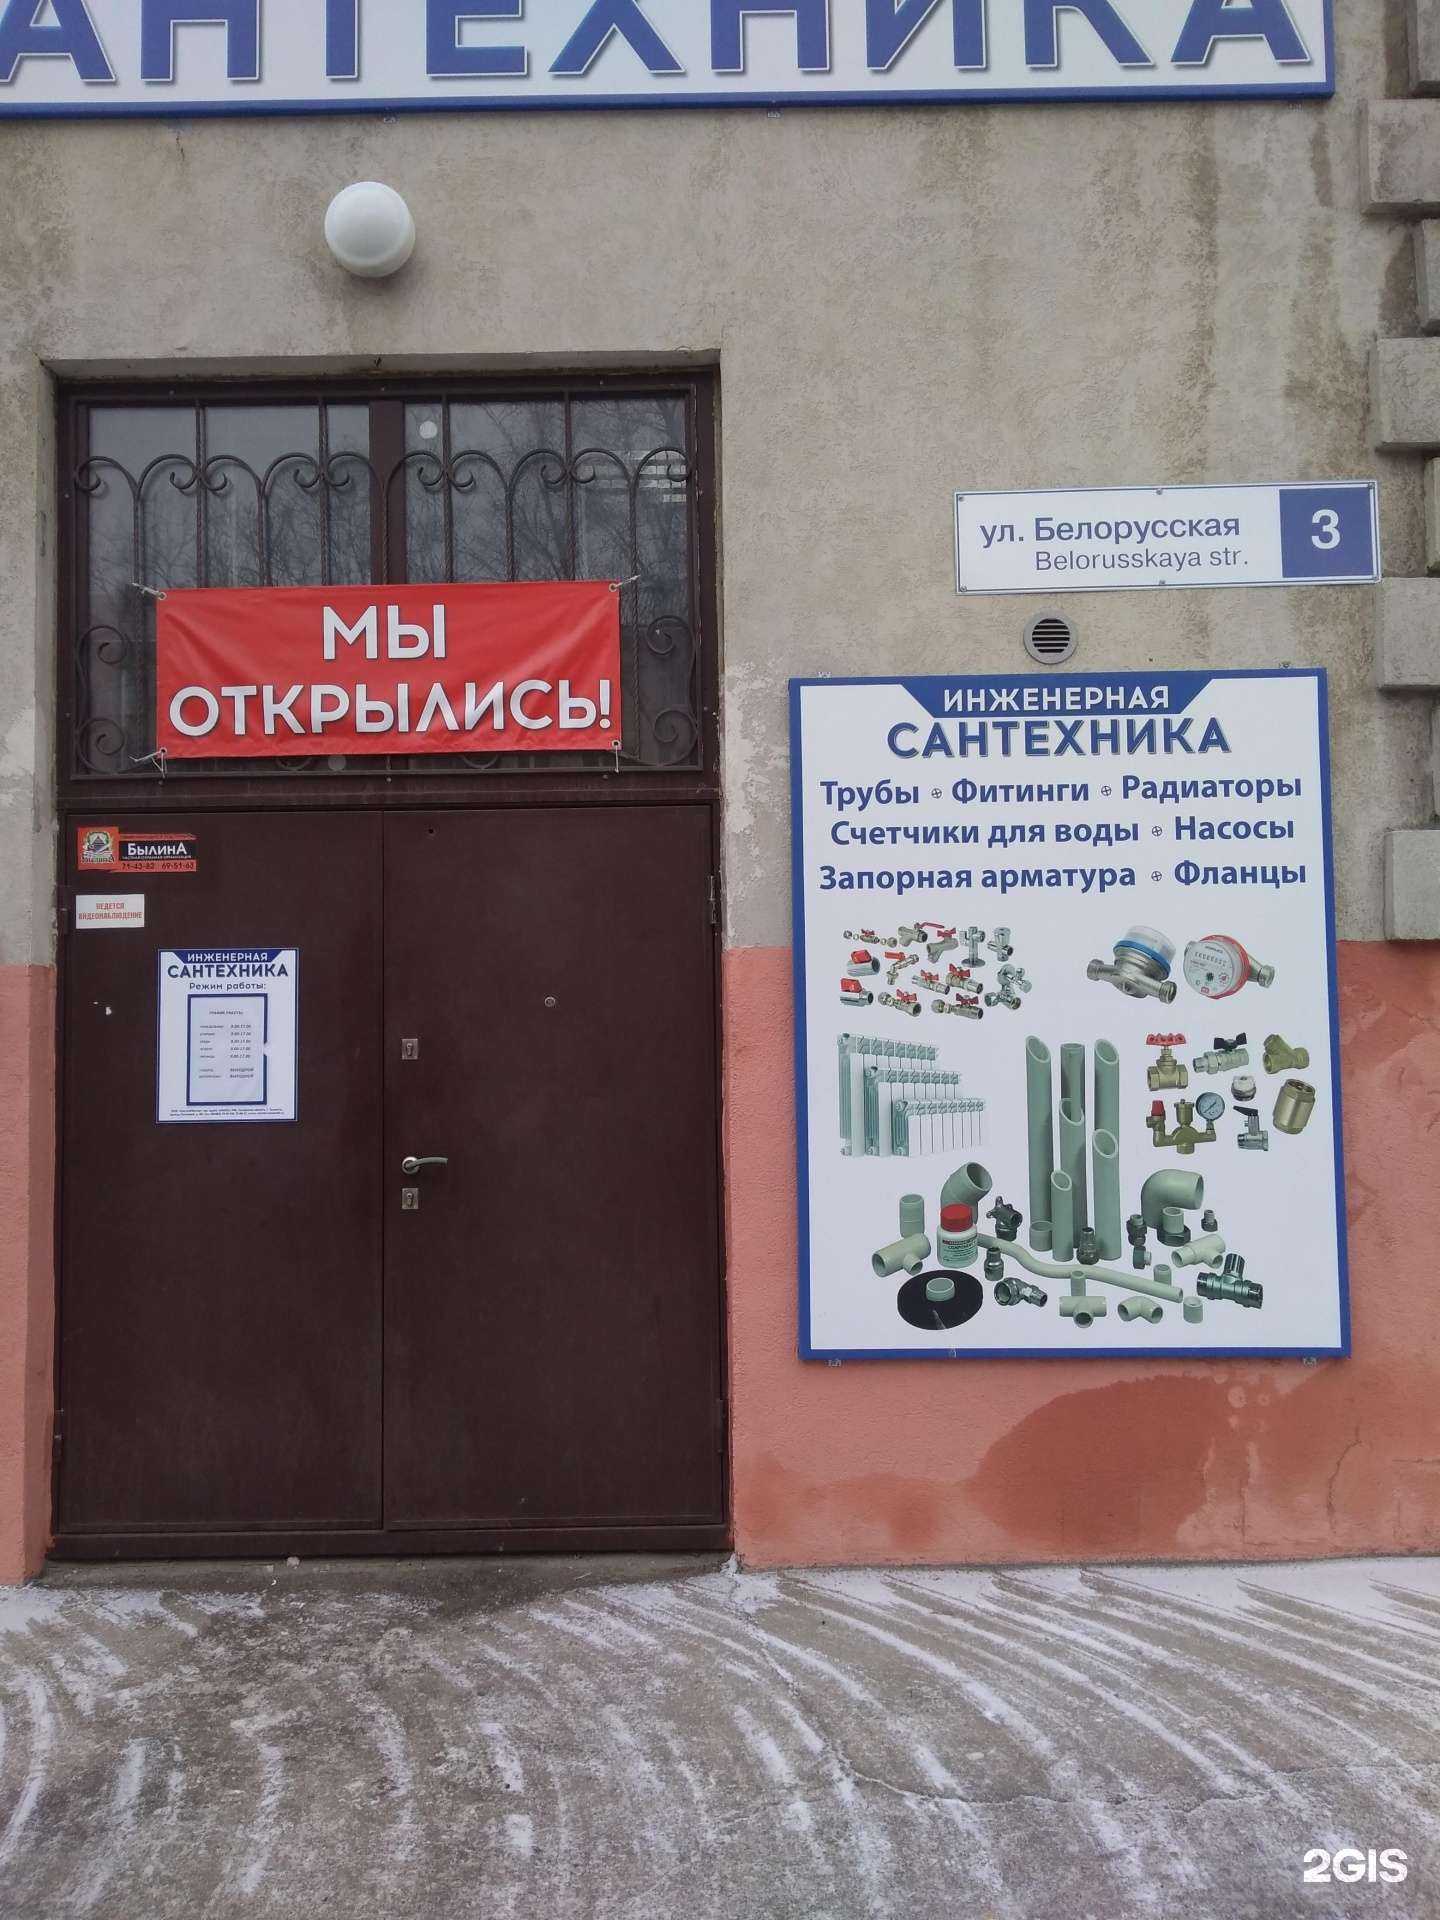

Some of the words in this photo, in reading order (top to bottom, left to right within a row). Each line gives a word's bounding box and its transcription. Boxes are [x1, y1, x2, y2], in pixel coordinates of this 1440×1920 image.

[980, 522, 1025, 548] ул.
[1034, 517, 1240, 546] Белорусская
[1311, 509, 1341, 549] 3
[1035, 547, 1202, 571] Belorusskaya
[1209, 547, 1249, 567] str.
[323, 604, 446, 660] МЫ
[169, 679, 612, 737] ОТКРЫЛИСЬ!
[944, 686, 1169, 711] ИНЖЕНЕРНАЯ
[887, 717, 1232, 759] САНТЕХНИКА
[820, 779, 919, 811] Трубы
[952, 778, 1089, 804] Фитинги
[1122, 774, 1302, 804] Радиаторы
[831, 821, 978, 847] Счетчики
[988, 825, 1046, 849] для
[1055, 823, 1139, 847] воды
[1175, 816, 1294, 841] Насосы
[820, 866, 972, 894] Запорная
[982, 867, 1136, 894] арматура
[1175, 860, 1306, 890] Фланцы
[167, 964, 288, 978] САНТЕХНИКА
[187, 952, 268, 962] ИНЖЕНЕРНАЯ
[226, 981, 267, 991] работы:
